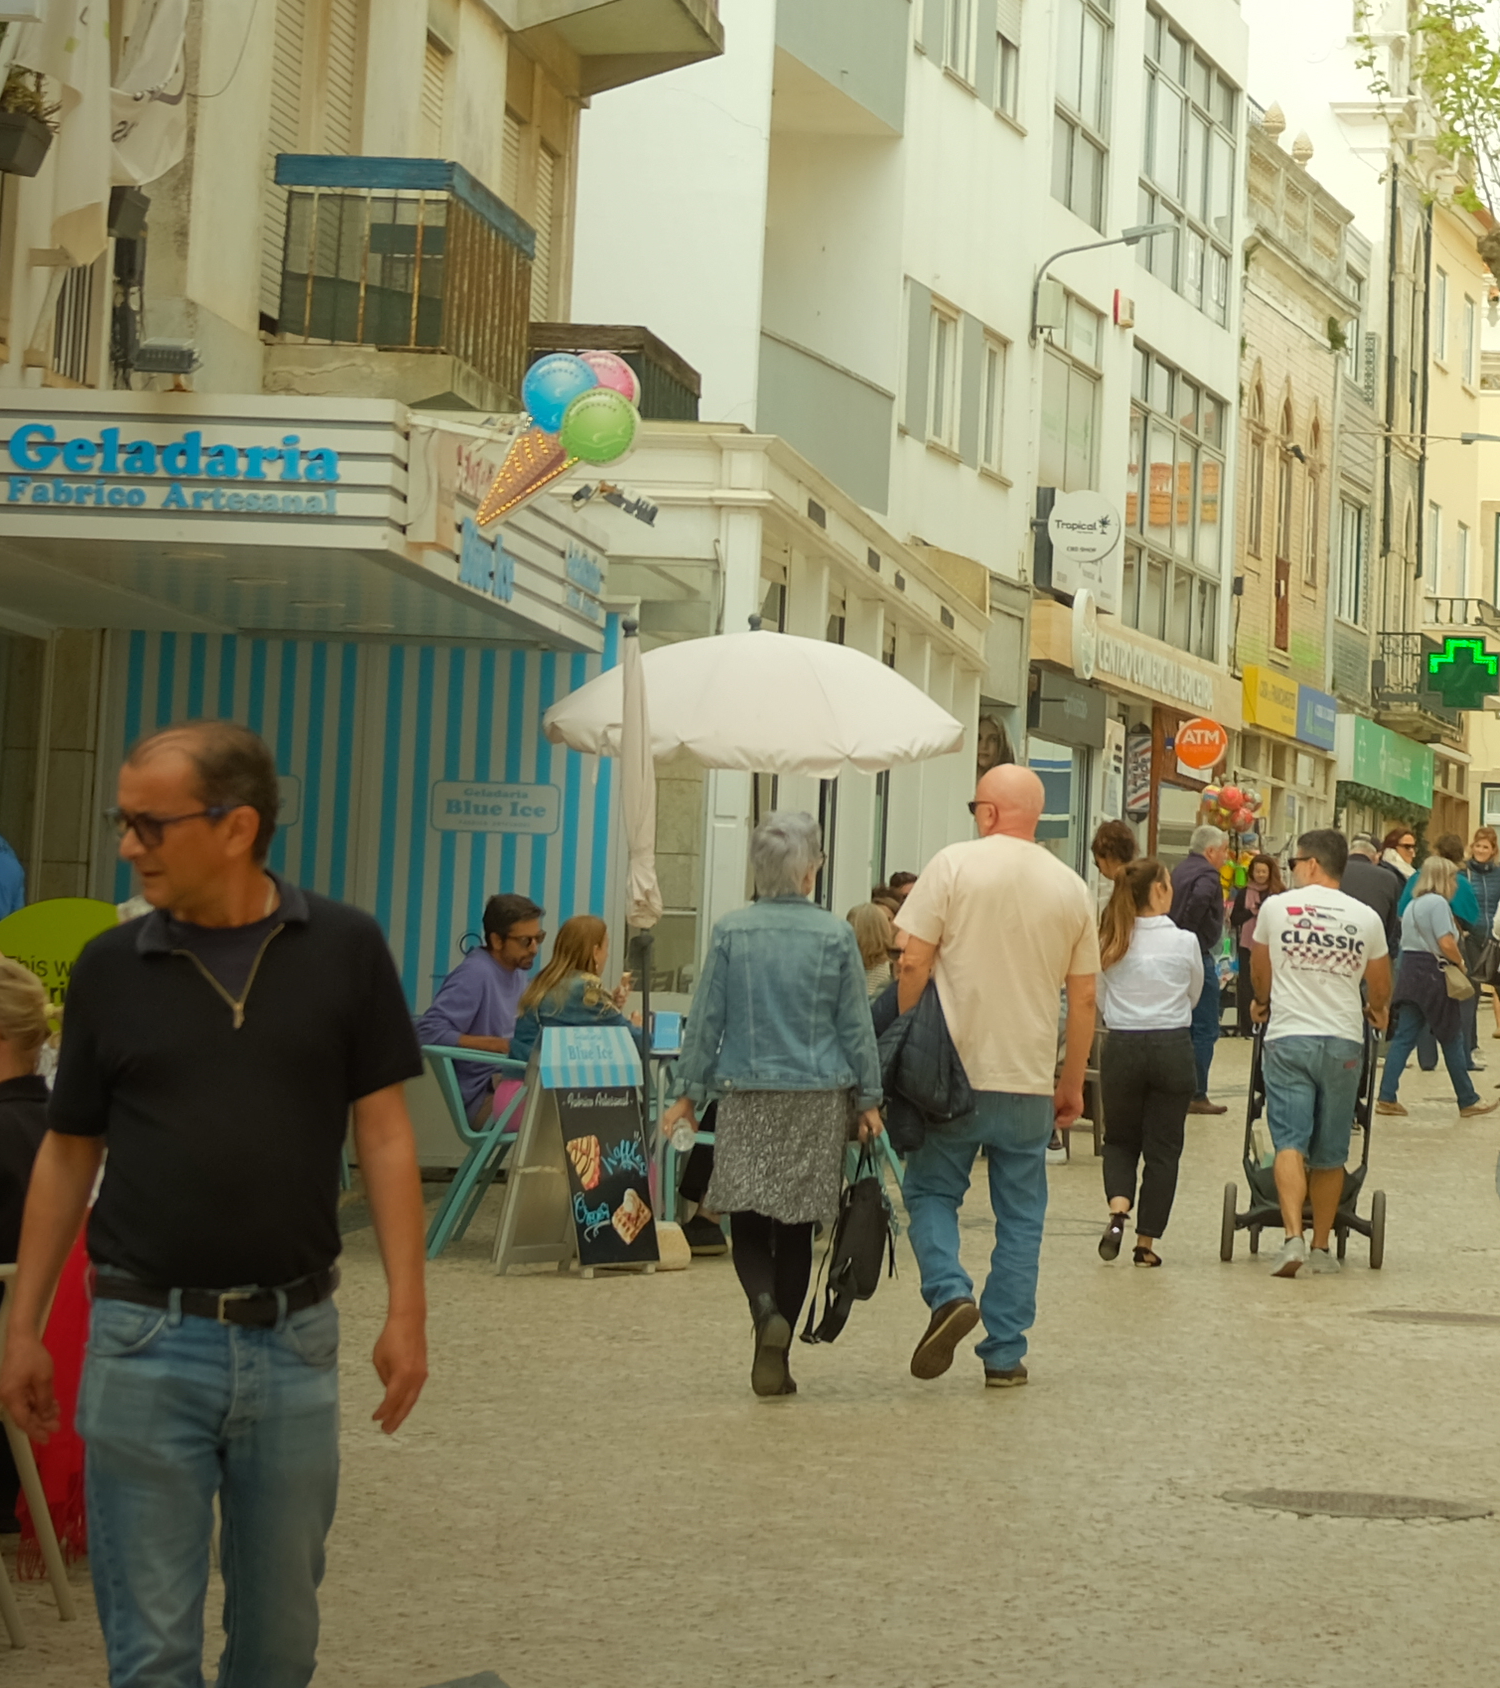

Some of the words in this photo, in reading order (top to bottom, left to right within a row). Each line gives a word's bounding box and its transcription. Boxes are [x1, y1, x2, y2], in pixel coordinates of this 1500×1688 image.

[8, 423, 340, 481] Geladaria
[8, 475, 146, 506] Fabrico
[162, 482, 337, 514] Artesanal
[1055, 518, 1097, 531] Tropical
[1182, 729, 1220, 745] ATM
[445, 798, 503, 817] Blue
[509, 801, 546, 819] Ice
[1281, 930, 1365, 955] CLASSIC
[567, 1045, 594, 1061] Blue
[597, 1046, 613, 1060] Ice
